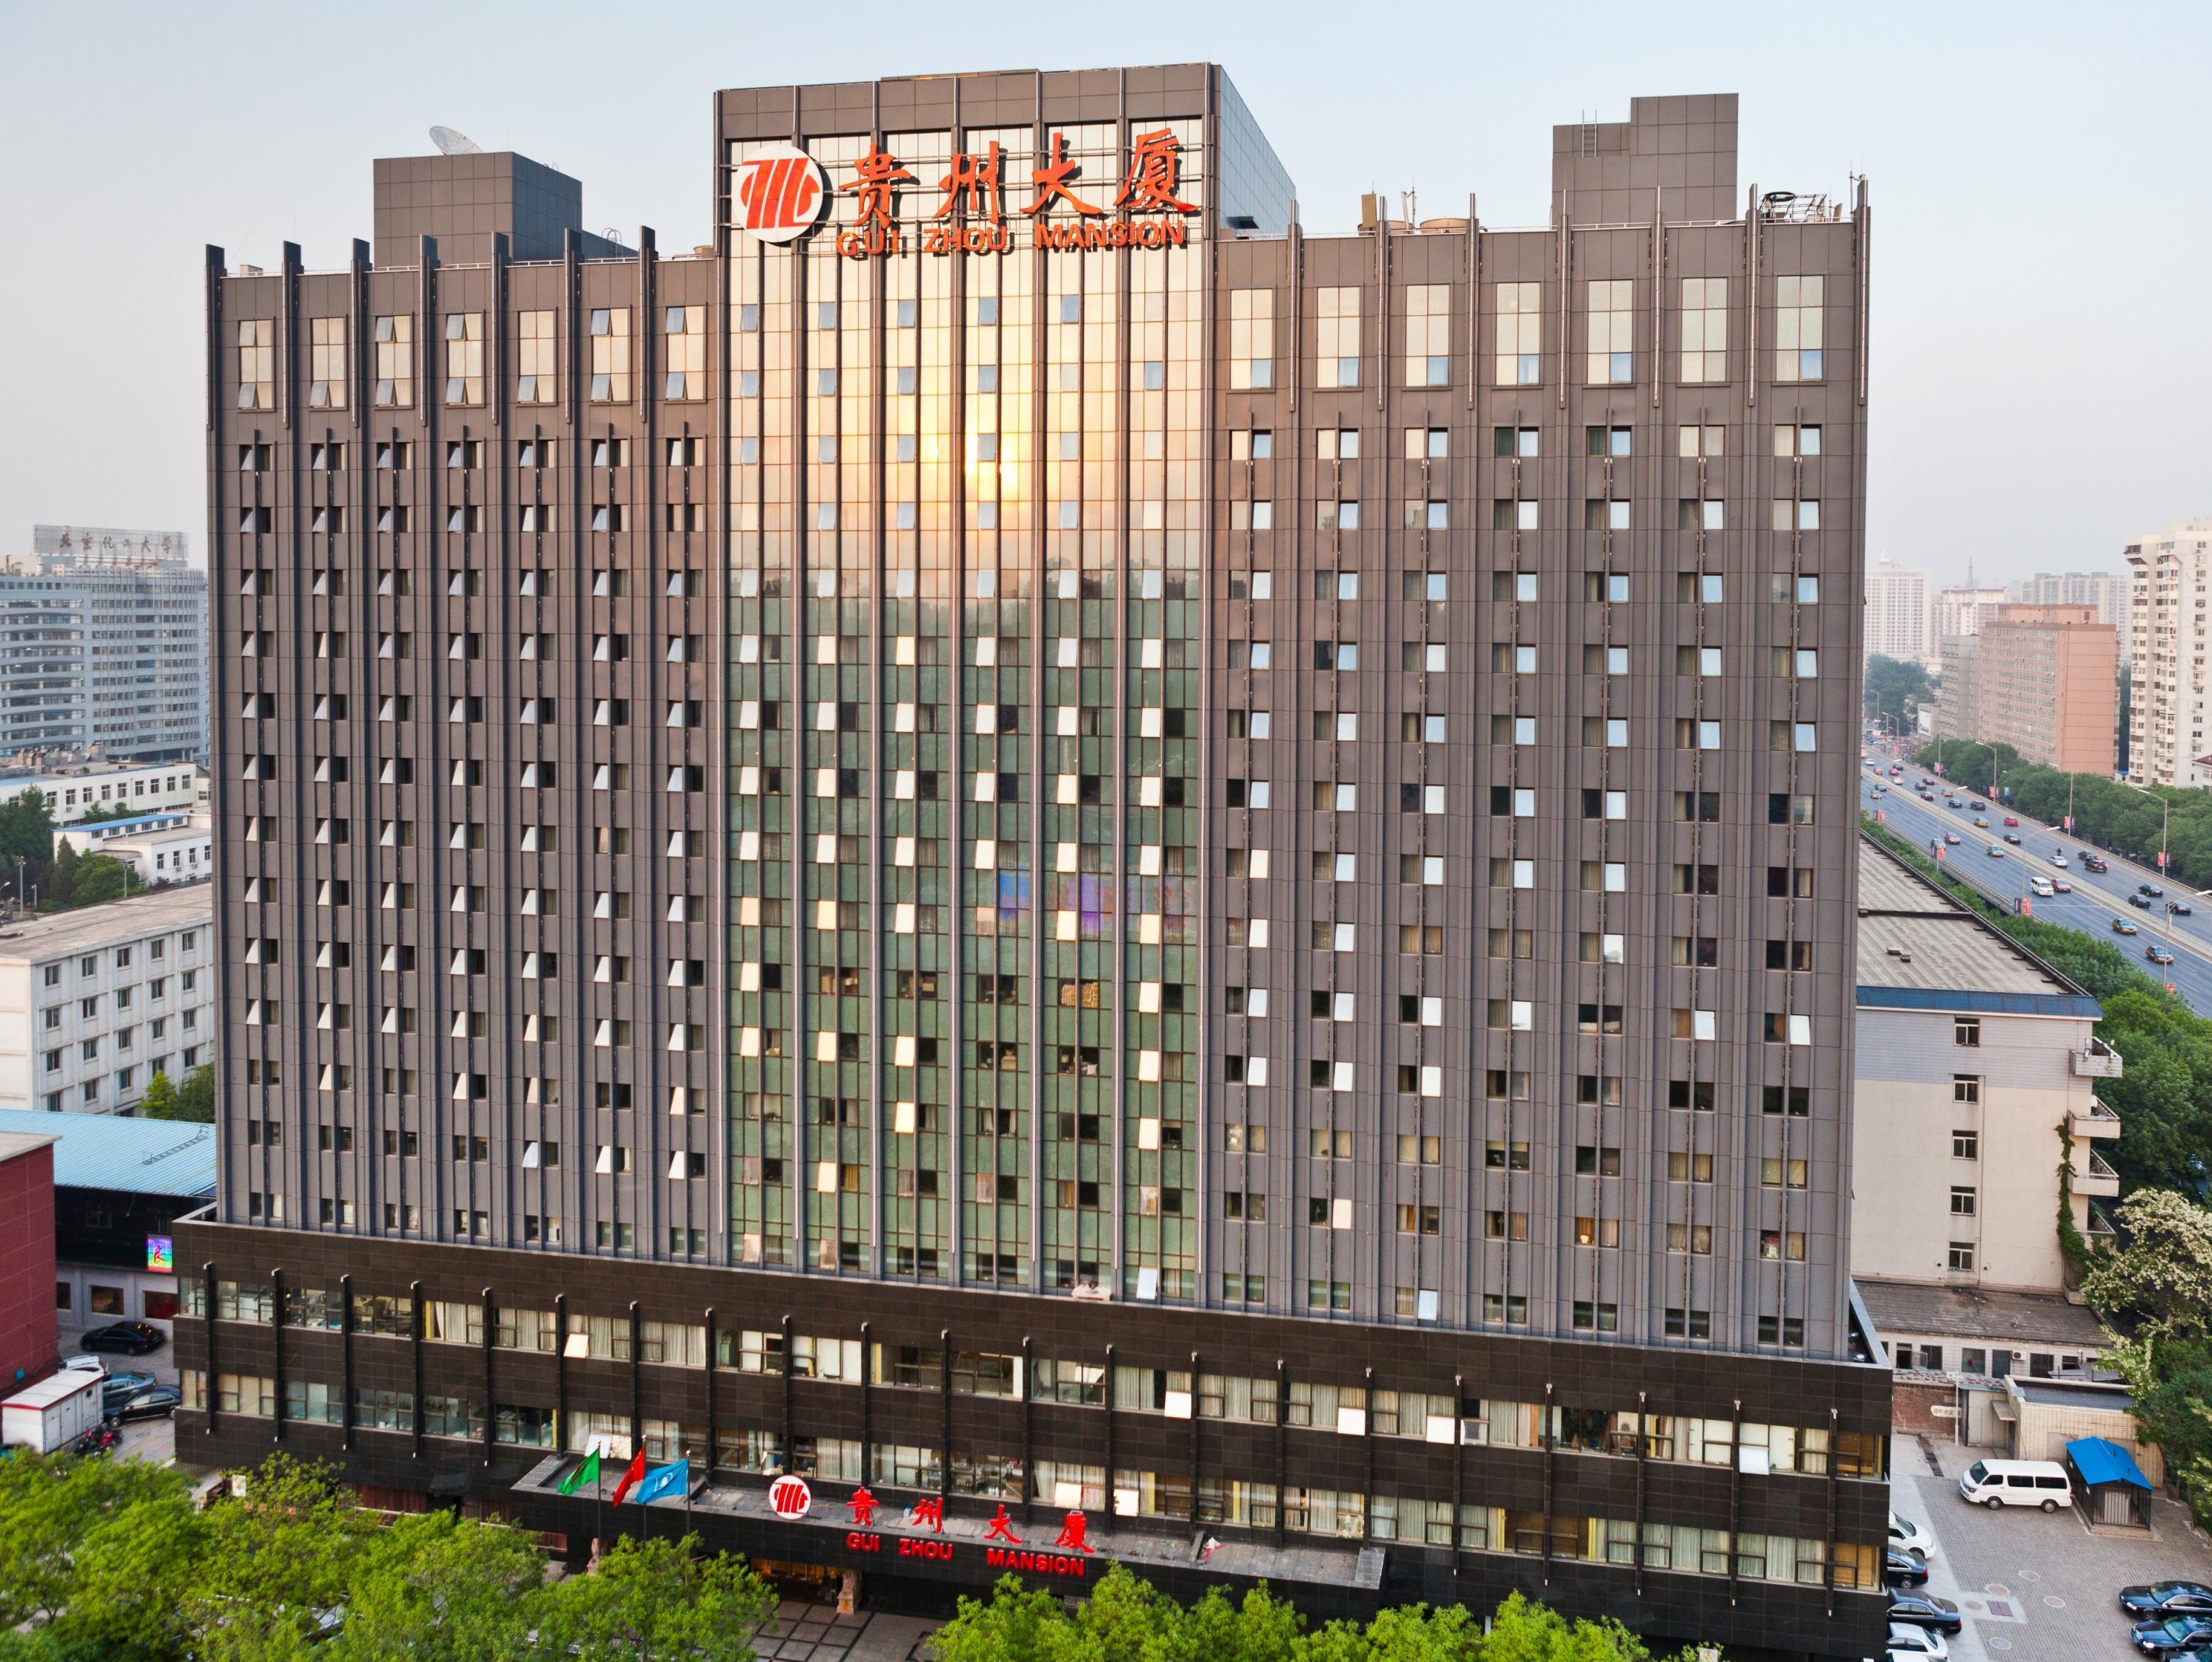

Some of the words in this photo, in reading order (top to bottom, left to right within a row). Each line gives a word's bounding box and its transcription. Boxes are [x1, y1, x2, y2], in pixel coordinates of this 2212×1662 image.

[839, 128, 1198, 228] 贵州大厦
[837, 230, 900, 257] GUI
[923, 225, 1008, 253] ZHOU
[1034, 220, 1183, 249] MANSION
[846, 1486, 1095, 1554] 贵州大厦
[846, 1532, 881, 1553] GUI
[898, 1538, 954, 1561] ZHOU
[986, 1548, 1085, 1576] MANSION
